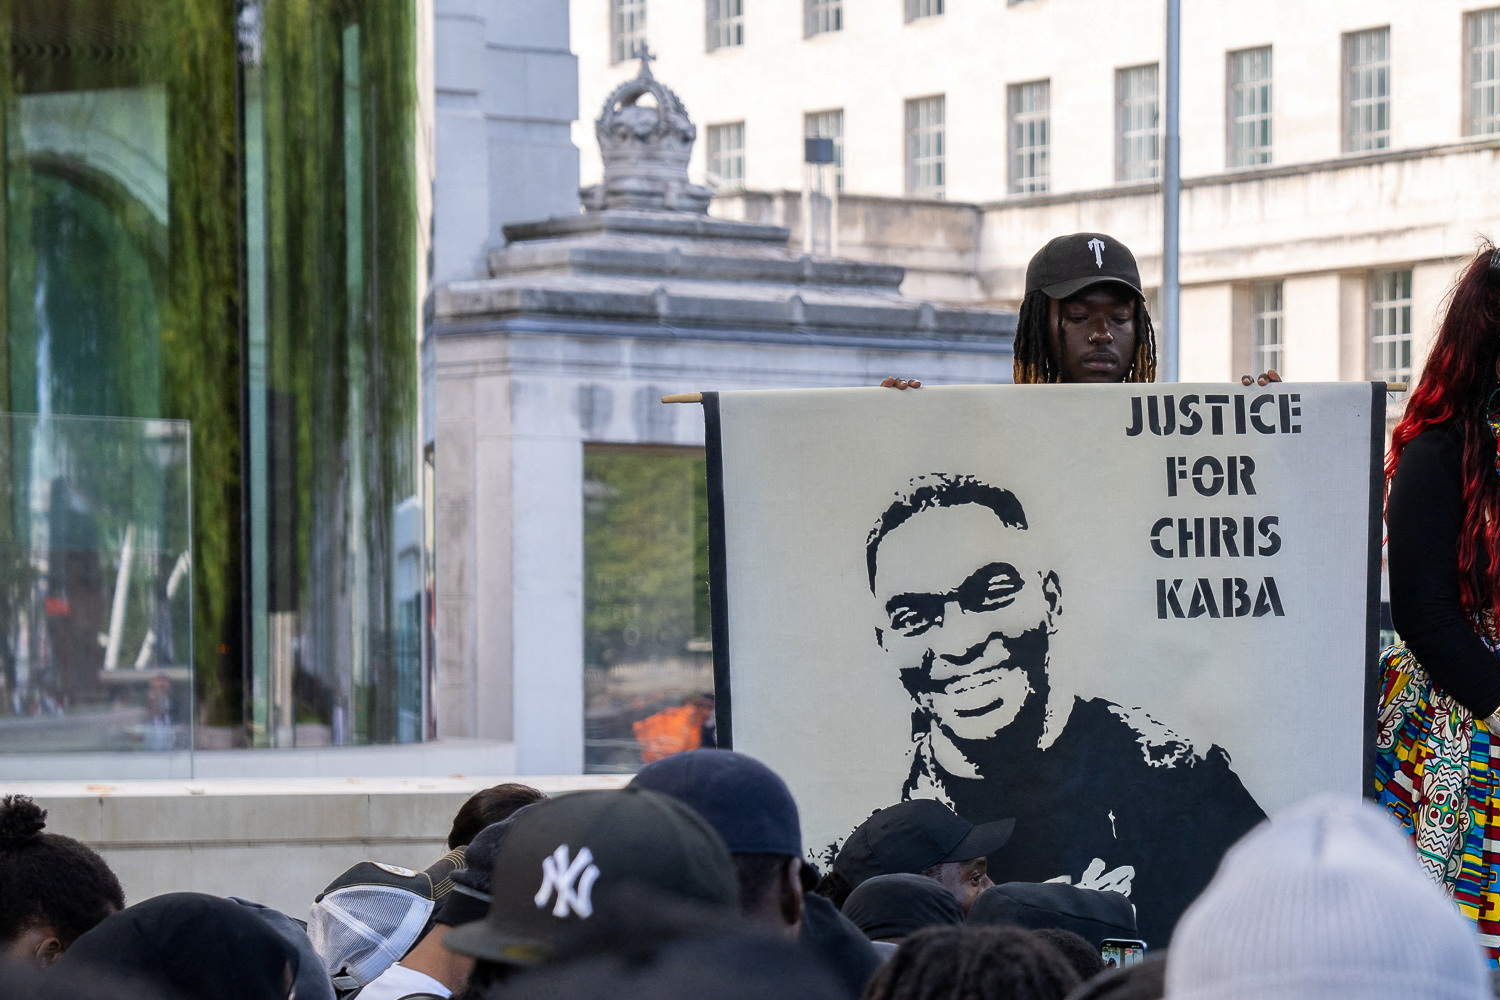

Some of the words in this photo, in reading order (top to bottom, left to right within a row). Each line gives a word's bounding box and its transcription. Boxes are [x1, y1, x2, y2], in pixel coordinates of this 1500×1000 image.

[1126, 394, 1301, 436] JUSTICE
[1166, 455, 1257, 497] FOR
[1150, 515, 1282, 558] CHRIS
[1156, 576, 1286, 619] KABA
